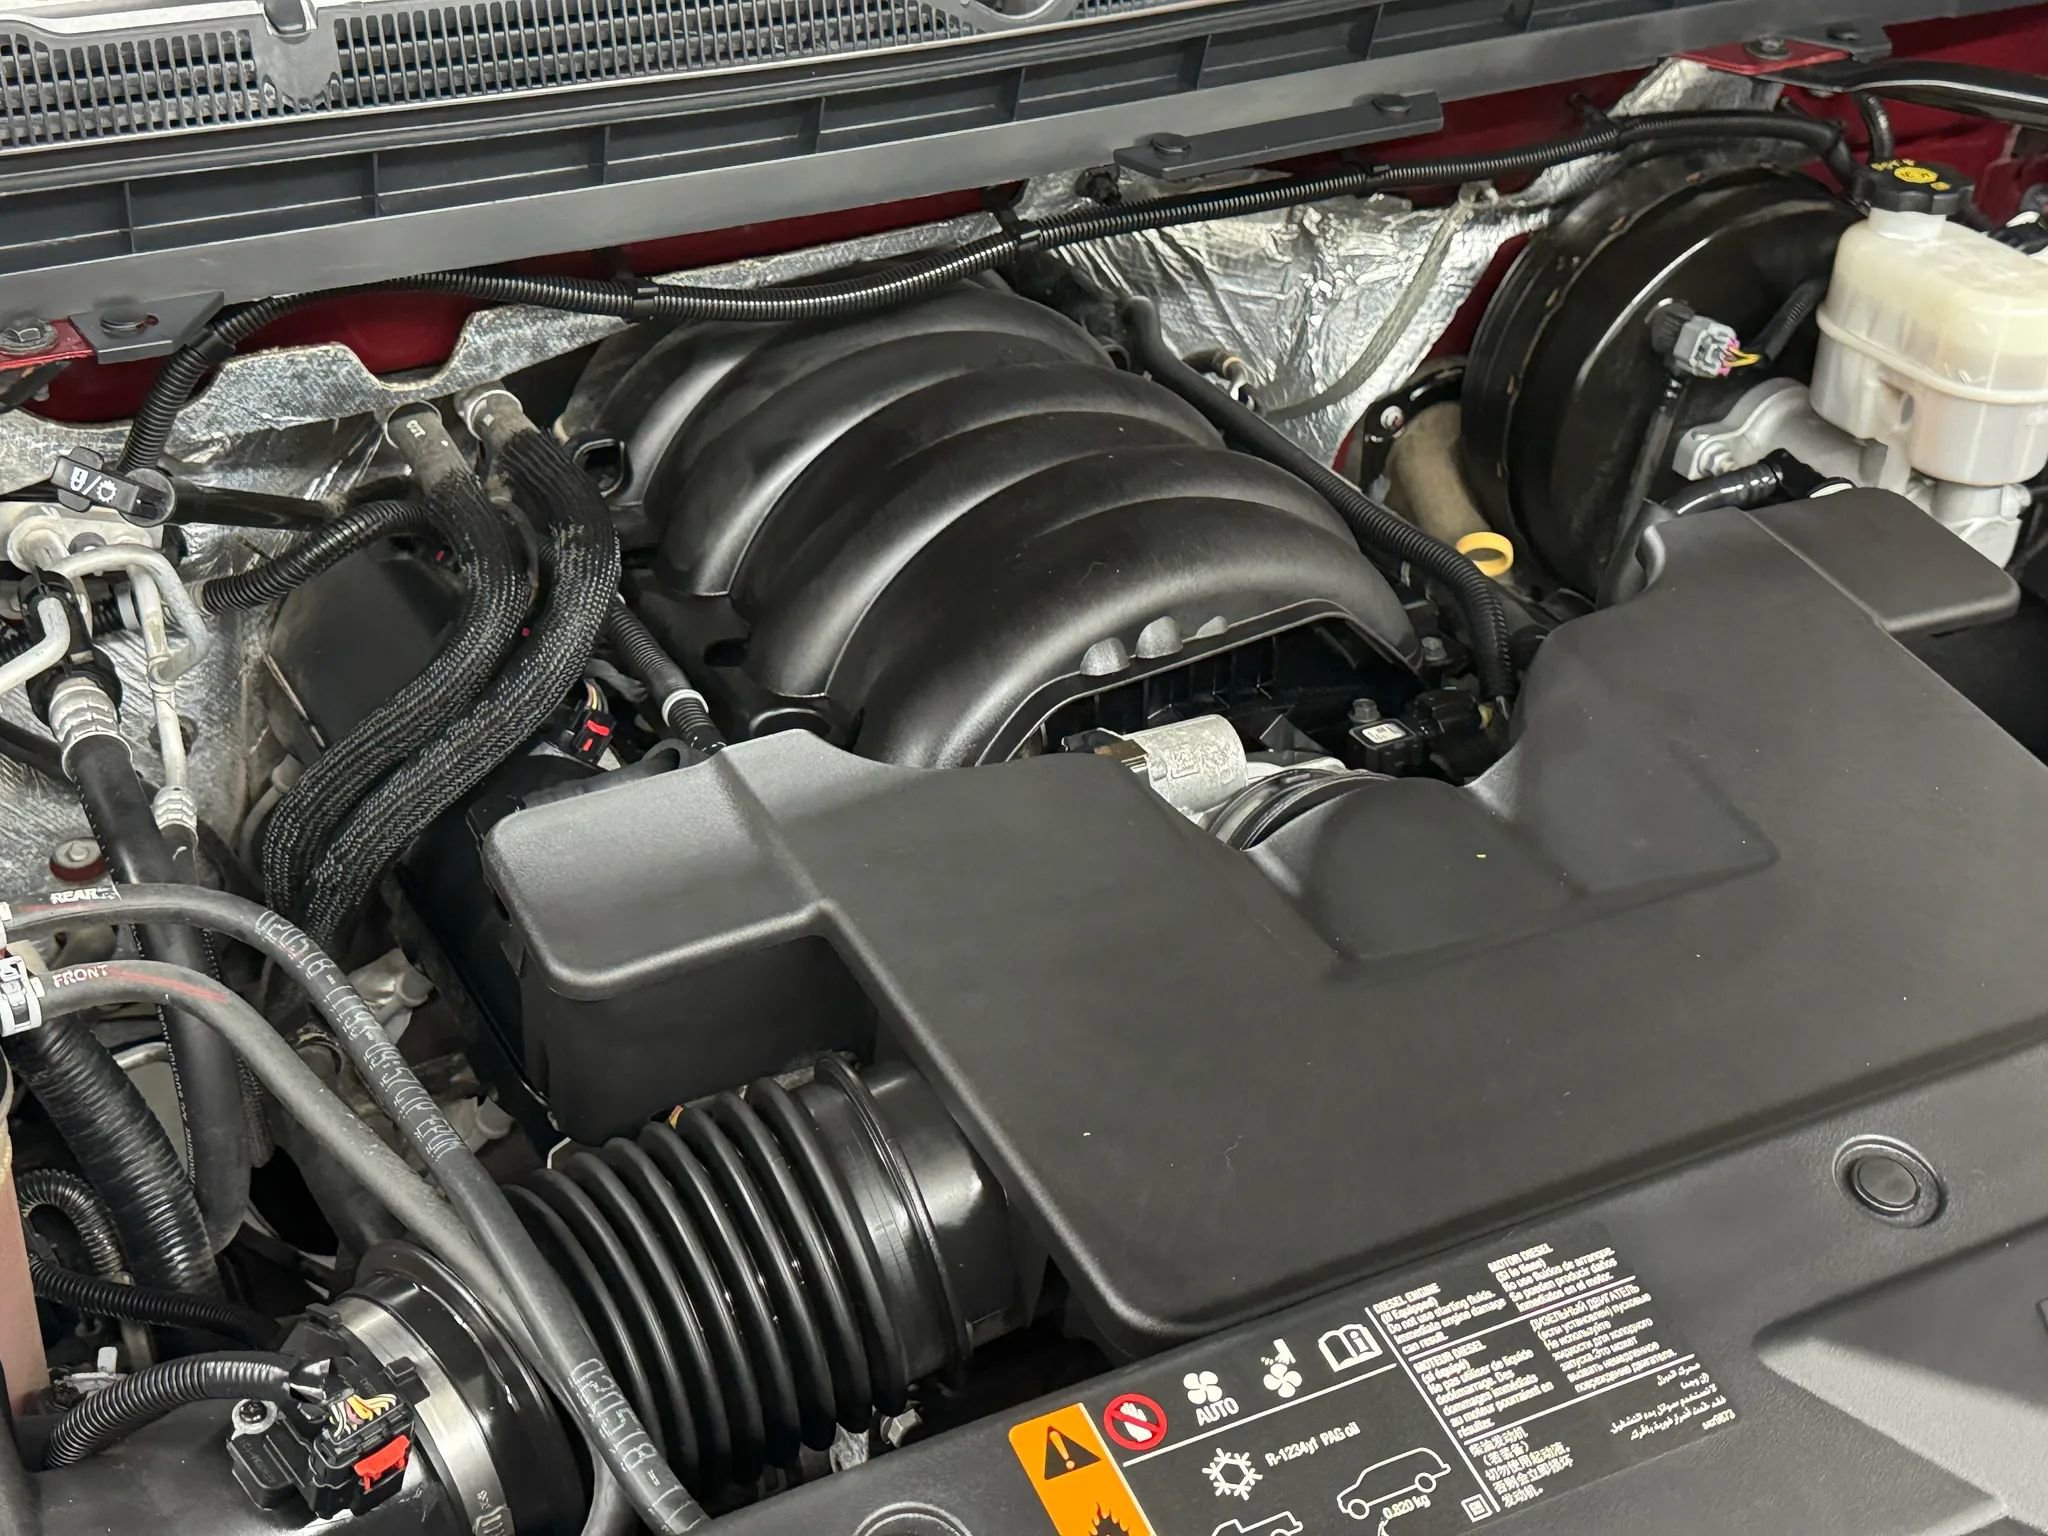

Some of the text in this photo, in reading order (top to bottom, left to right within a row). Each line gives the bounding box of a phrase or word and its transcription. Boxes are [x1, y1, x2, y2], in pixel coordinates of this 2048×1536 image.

[52, 964, 108, 988] FRONT
[1487, 1243, 1554, 1273] MOTOR DIESEL
[1501, 1281, 1517, 1292] No
[1516, 1275, 1534, 1287] use
[1562, 1261, 1575, 1271] de
[1509, 1258, 1617, 1302] Se pueden producir daños
[1564, 1285, 1577, 1295] en
[1576, 1280, 1587, 1291] el
[1373, 1283, 1441, 1314] DIESEL ENGINE
[1441, 1310, 1472, 1327] engine
[1470, 1298, 1507, 1317] damage
[1530, 1284, 1640, 1332] ДИЗЕЛЬНЫЙ ДВИГАТЕЛЬ
[1386, 1323, 1402, 1335] Do
[1401, 1317, 1419, 1330] not
[1416, 1311, 1435, 1324] use
[1433, 1299, 1470, 1317] starting
[1402, 1342, 1420, 1355] can
[1413, 1340, 1487, 1374] MOTEUR DIESEL
[1544, 1339, 1560, 1351] Не
[1427, 1349, 1534, 1395] Ne pas utiliser de liquide
[1494, 1369, 1515, 1383] Des
[1195, 1397, 1239, 1426] AUTO
[1443, 1391, 1493, 1416] dommages
[1450, 1416, 1464, 1428] au
[1462, 1403, 1495, 1422] moteur
[1540, 1381, 1554, 1393] en
[1320, 1424, 1346, 1447] PAG
[1343, 1421, 1361, 1437] oil
[1382, 1494, 1432, 1521] 0.820 kg
